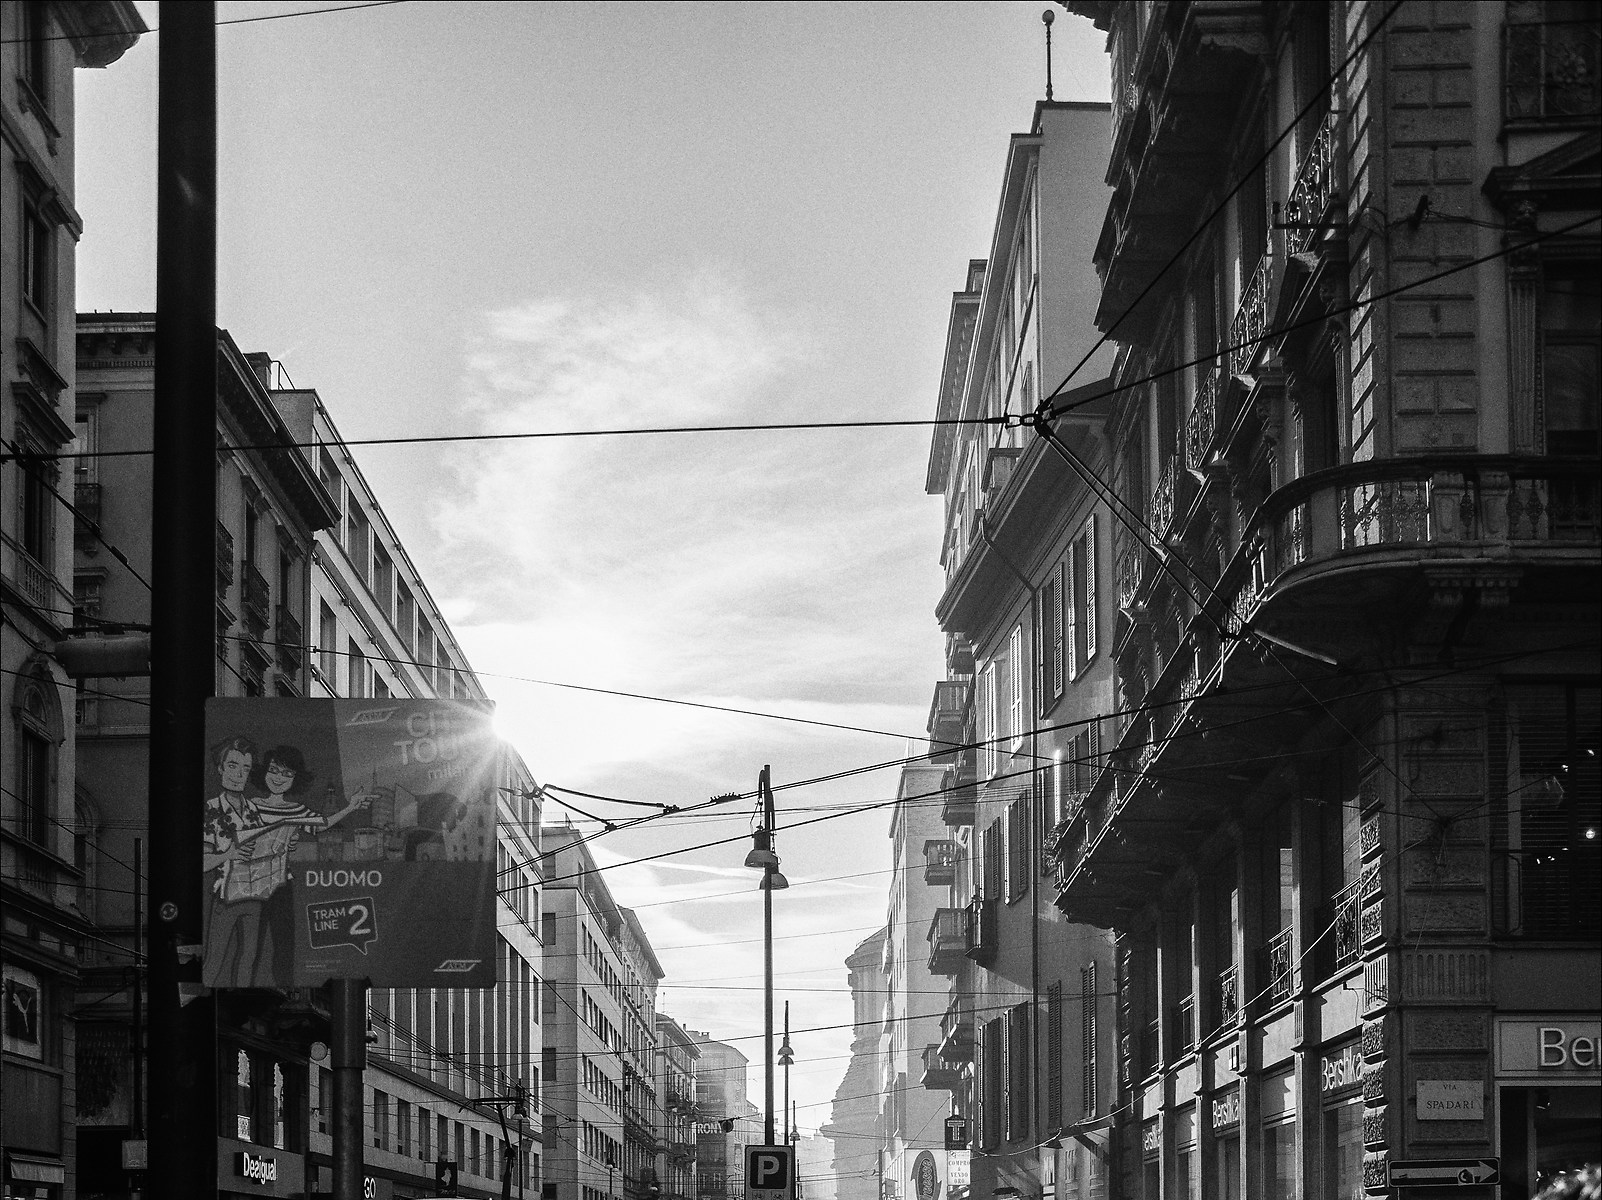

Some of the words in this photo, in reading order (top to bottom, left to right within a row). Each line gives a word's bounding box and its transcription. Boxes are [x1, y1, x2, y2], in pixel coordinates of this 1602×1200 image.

[393, 735, 466, 766] TOU
[305, 870, 382, 888] DUOMO
[313, 907, 346, 920] TRAM
[348, 904, 372, 936] 2
[314, 919, 340, 932] LINE
[1322, 1046, 1362, 1092] Bershka
[1426, 1101, 1475, 1110] SPADARI
[243, 1152, 277, 1185] Desigual
[757, 1155, 780, 1185] P
